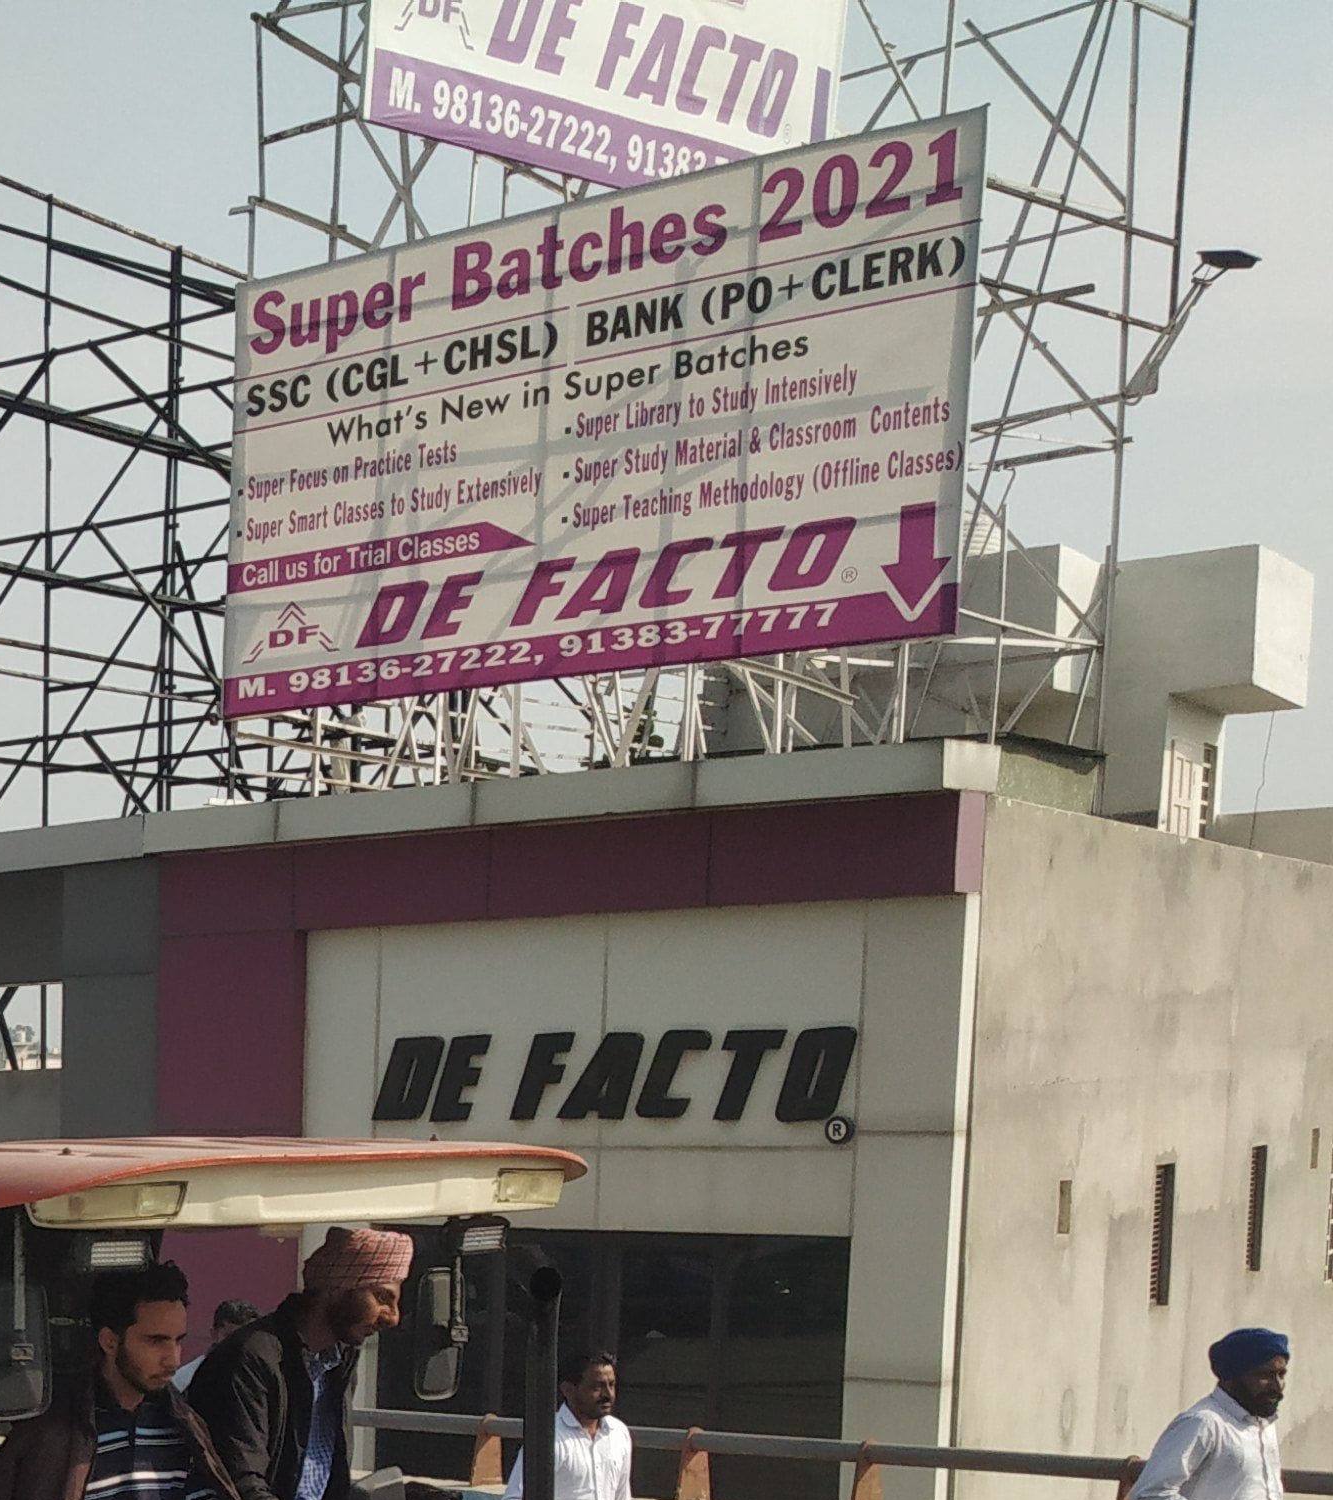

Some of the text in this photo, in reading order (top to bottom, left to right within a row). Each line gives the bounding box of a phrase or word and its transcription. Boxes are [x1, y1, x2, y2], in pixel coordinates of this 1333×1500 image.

[486, 0, 799, 139] DE FACTO
[388, 66, 421, 113] M.
[432, 79, 617, 172] 98136-27222,
[250, 128, 963, 355] Super Batches 2021
[246, 374, 311, 418] SSC
[586, 292, 685, 347] BANK
[327, 335, 810, 447] What's New in Super Batches
[575, 363, 858, 440] Super Library to Study Intensively
[247, 440, 458, 502] Super Focus on Practice Tests
[572, 440, 964, 531] Super Teaching Methodology (Offline Classes)
[574, 397, 950, 488] Super Study Material & Classroom Contents
[246, 466, 543, 544] Super Smart Classes to Study Extensively
[242, 530, 481, 588] Call us for Trial Classes
[268, 516, 857, 649] DF DE FACTO
[238, 602, 839, 700] M. 98136-27222, 91383-77777
[370, 1025, 858, 1123] DE FACTO
